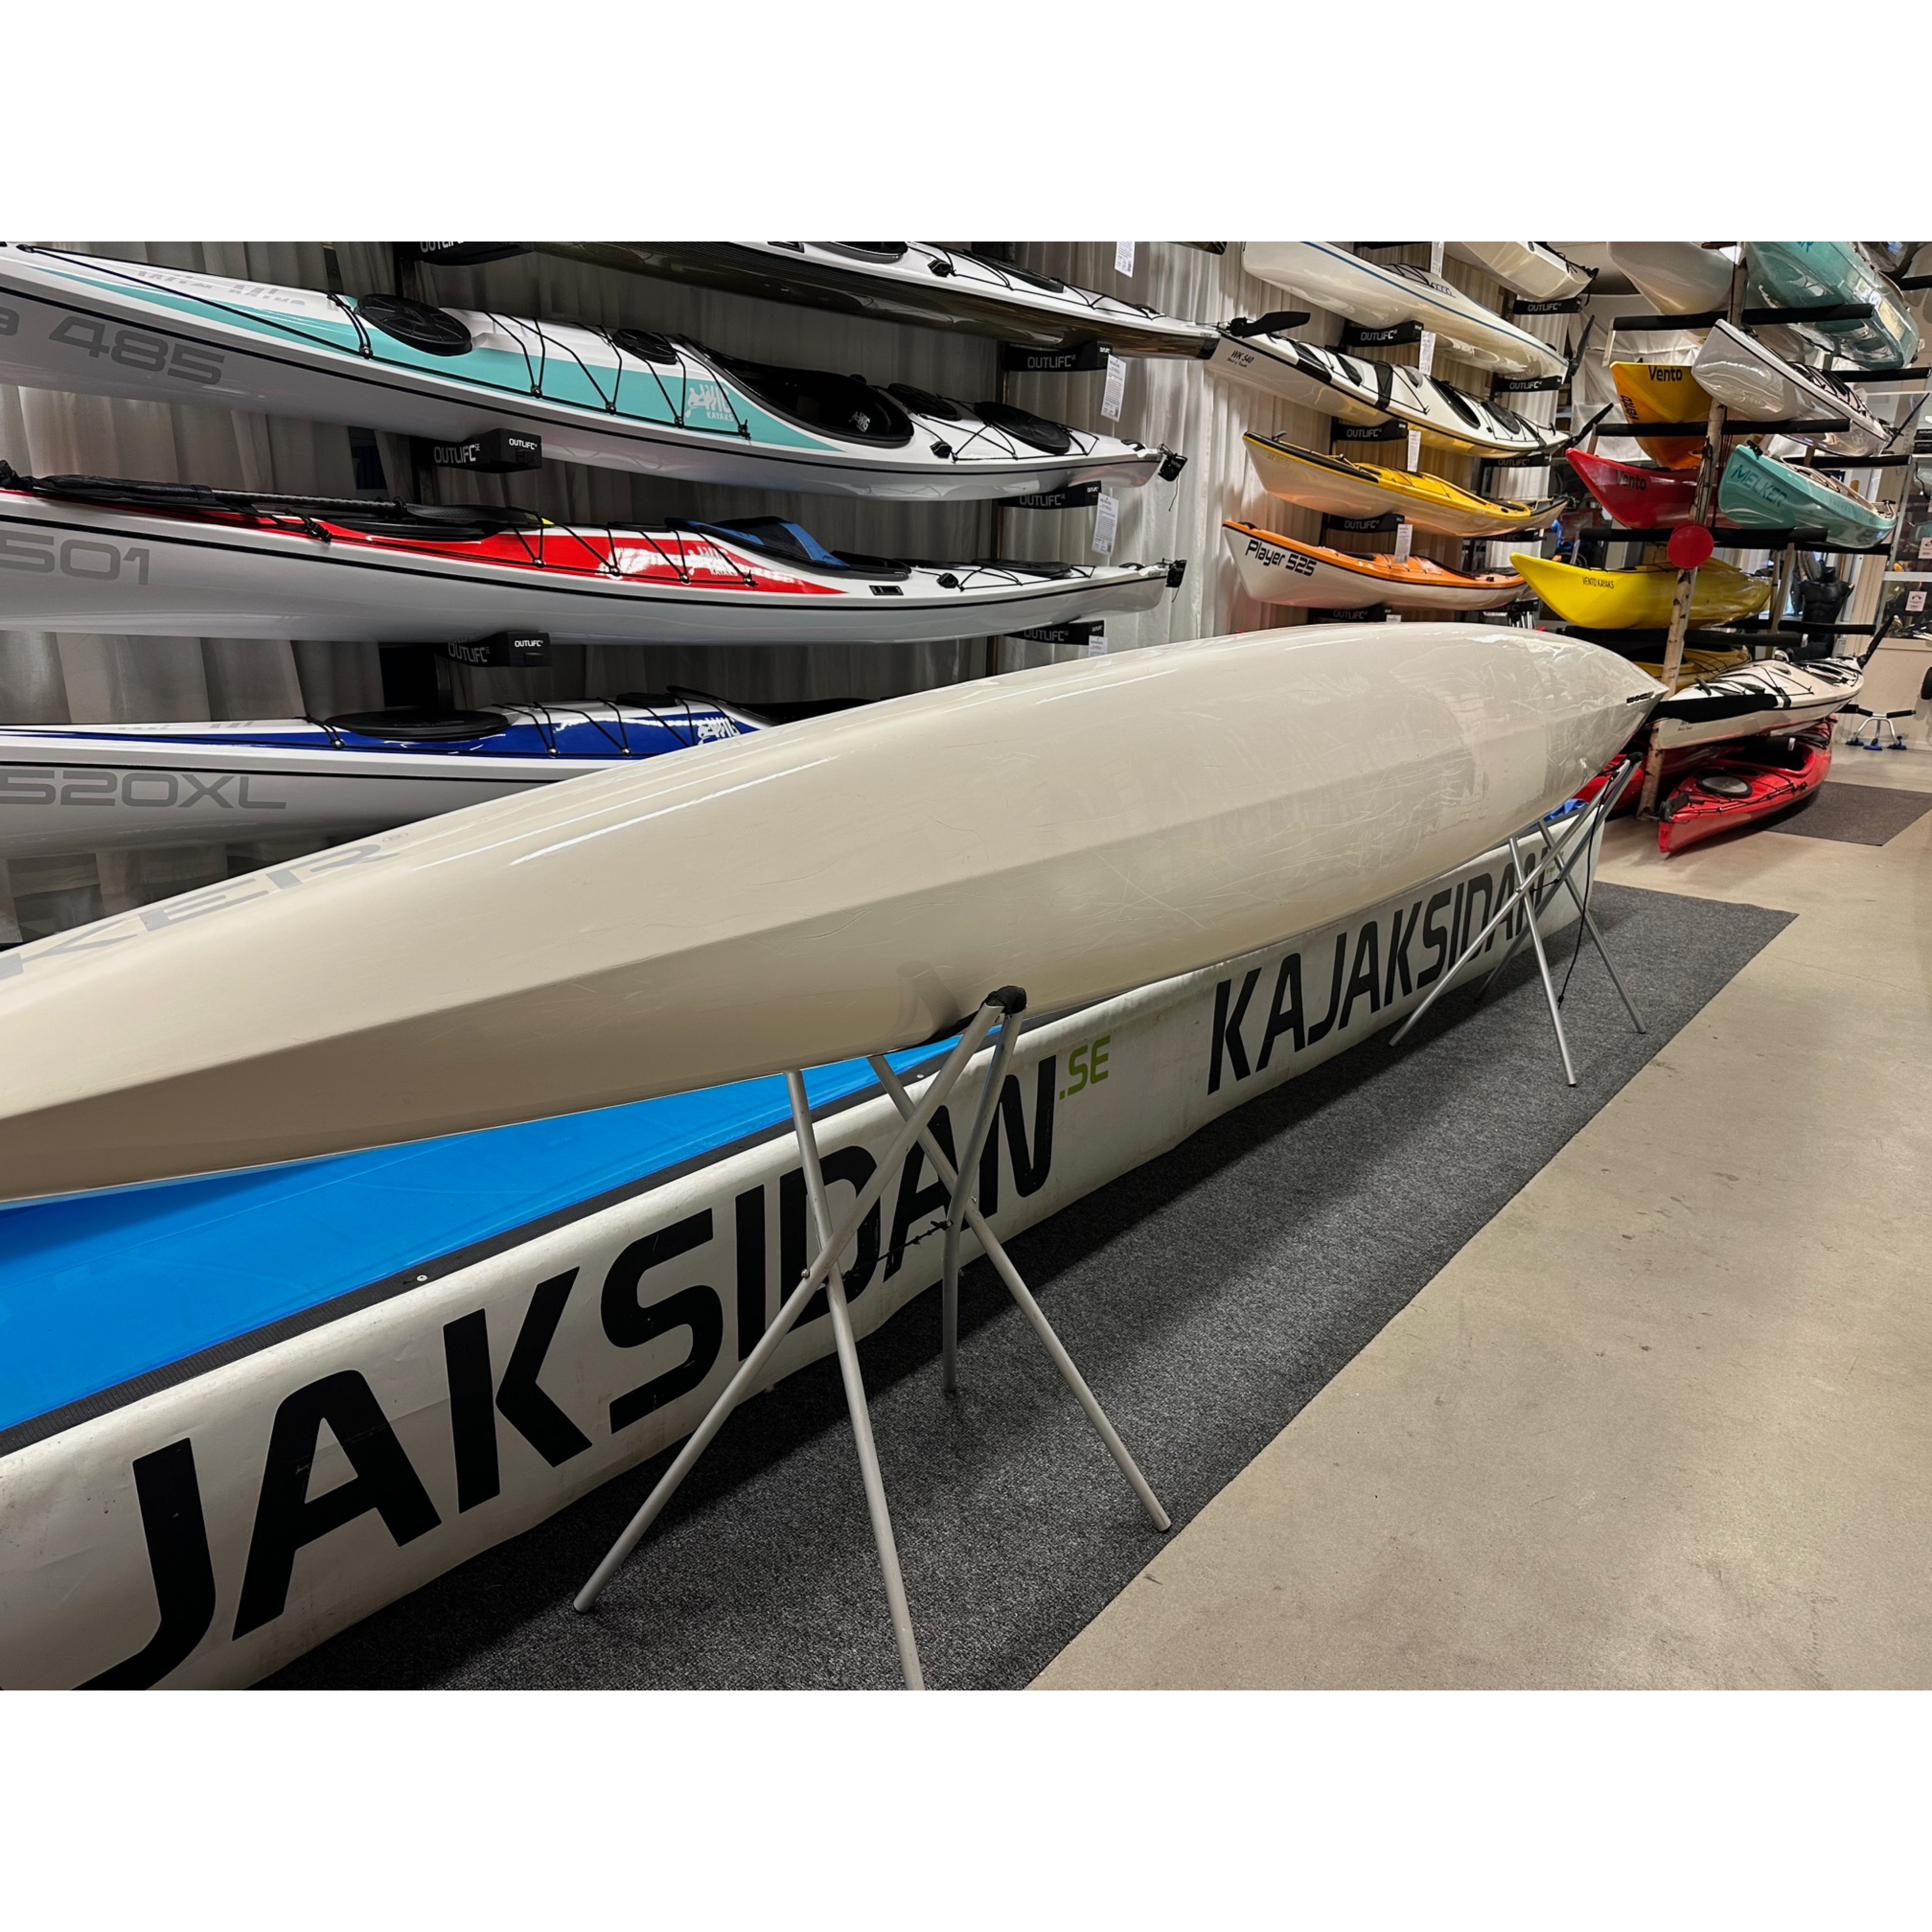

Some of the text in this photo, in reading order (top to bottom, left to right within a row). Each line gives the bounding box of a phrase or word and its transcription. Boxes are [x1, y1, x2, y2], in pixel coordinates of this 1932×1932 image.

[49, 315, 225, 385] 485
[1027, 355, 1071, 369] OUTLIFC
[1648, 365, 1682, 382] Vento
[706, 411, 734, 422] KAYAKS
[1620, 394, 1639, 420] Vento
[434, 444, 477, 464] OUTLIFC
[1615, 469, 1647, 491] Vento
[1731, 464, 1787, 508] MELKER
[0, 531, 150, 586] 501
[1245, 539, 1317, 577] Player 525
[1582, 576, 1614, 589] VENTO KAYAKS
[448, 641, 488, 663] OUTLIFC
[0, 768, 286, 810] 520XL
